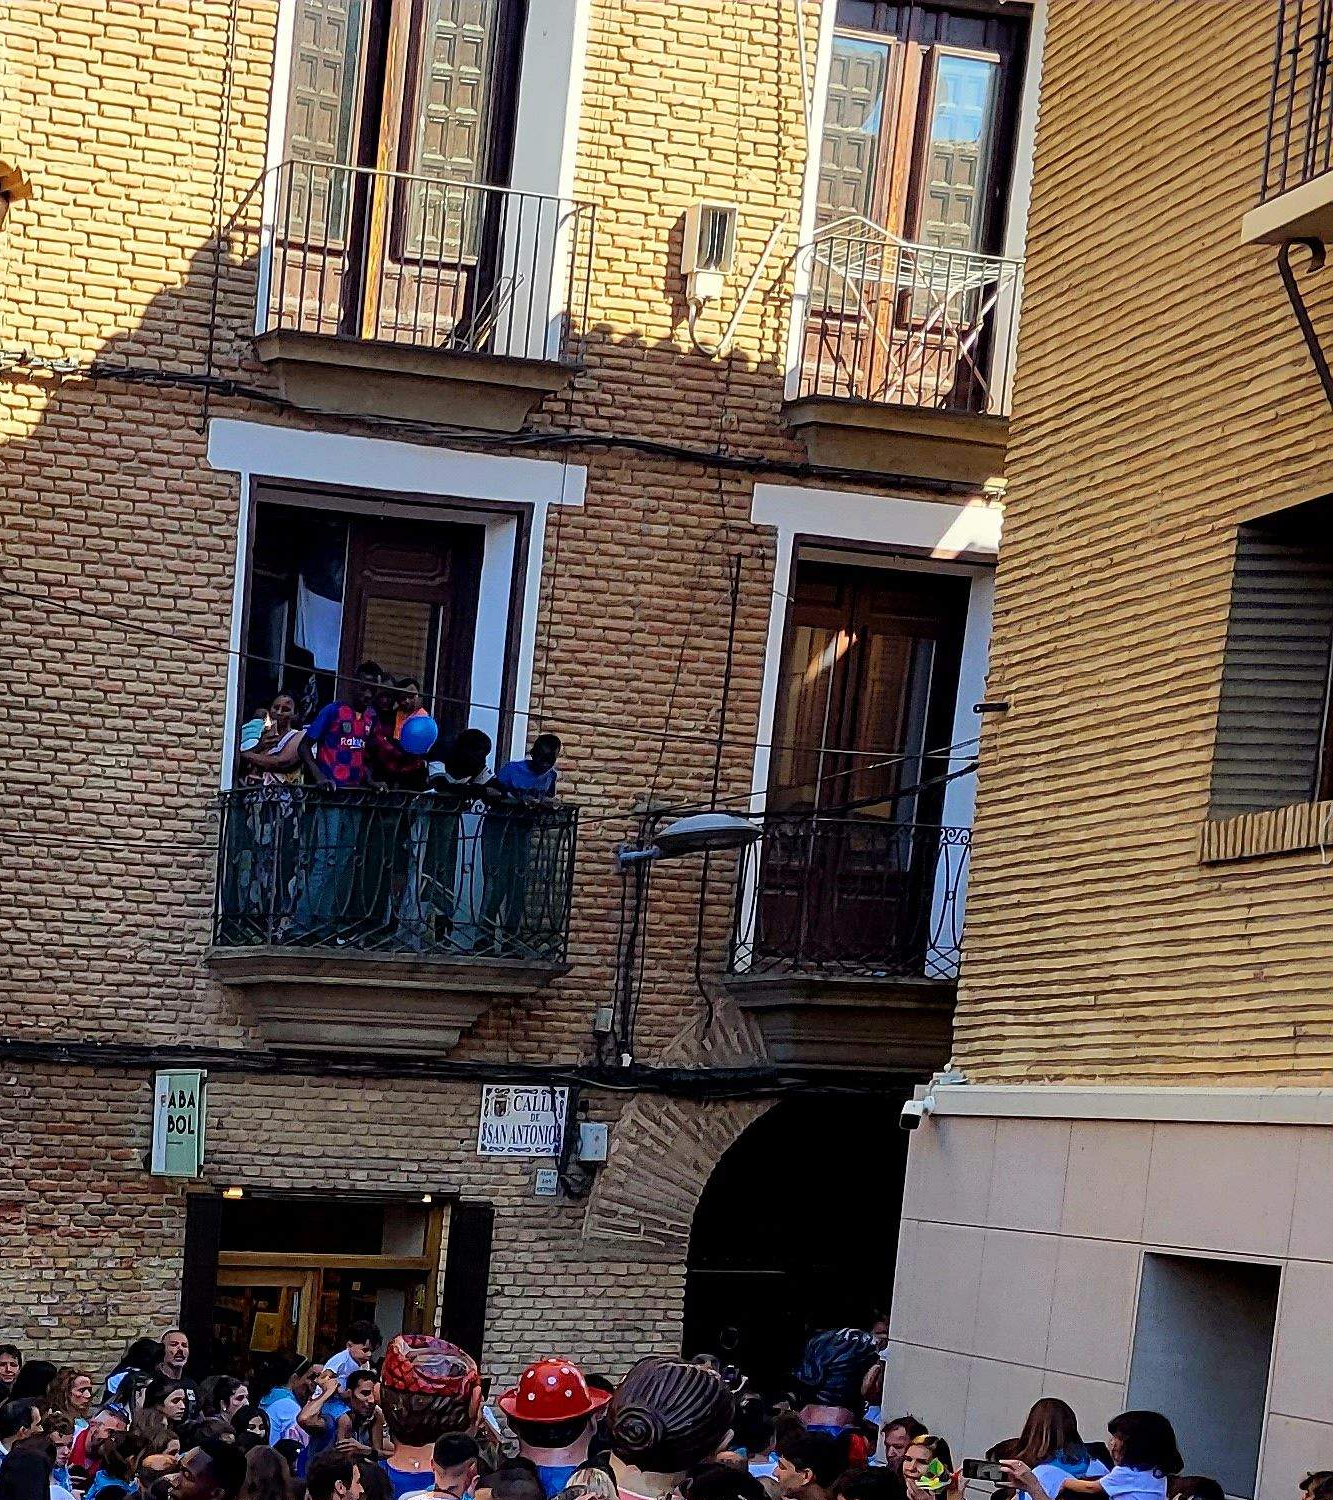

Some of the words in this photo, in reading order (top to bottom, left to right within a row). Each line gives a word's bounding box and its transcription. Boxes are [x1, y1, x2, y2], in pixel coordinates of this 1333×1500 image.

[167, 1114, 195, 1134] BOL
[529, 1113, 540, 1122] DE
[487, 1124, 508, 1144] SAN
[509, 1124, 555, 1145] ANTONIO
